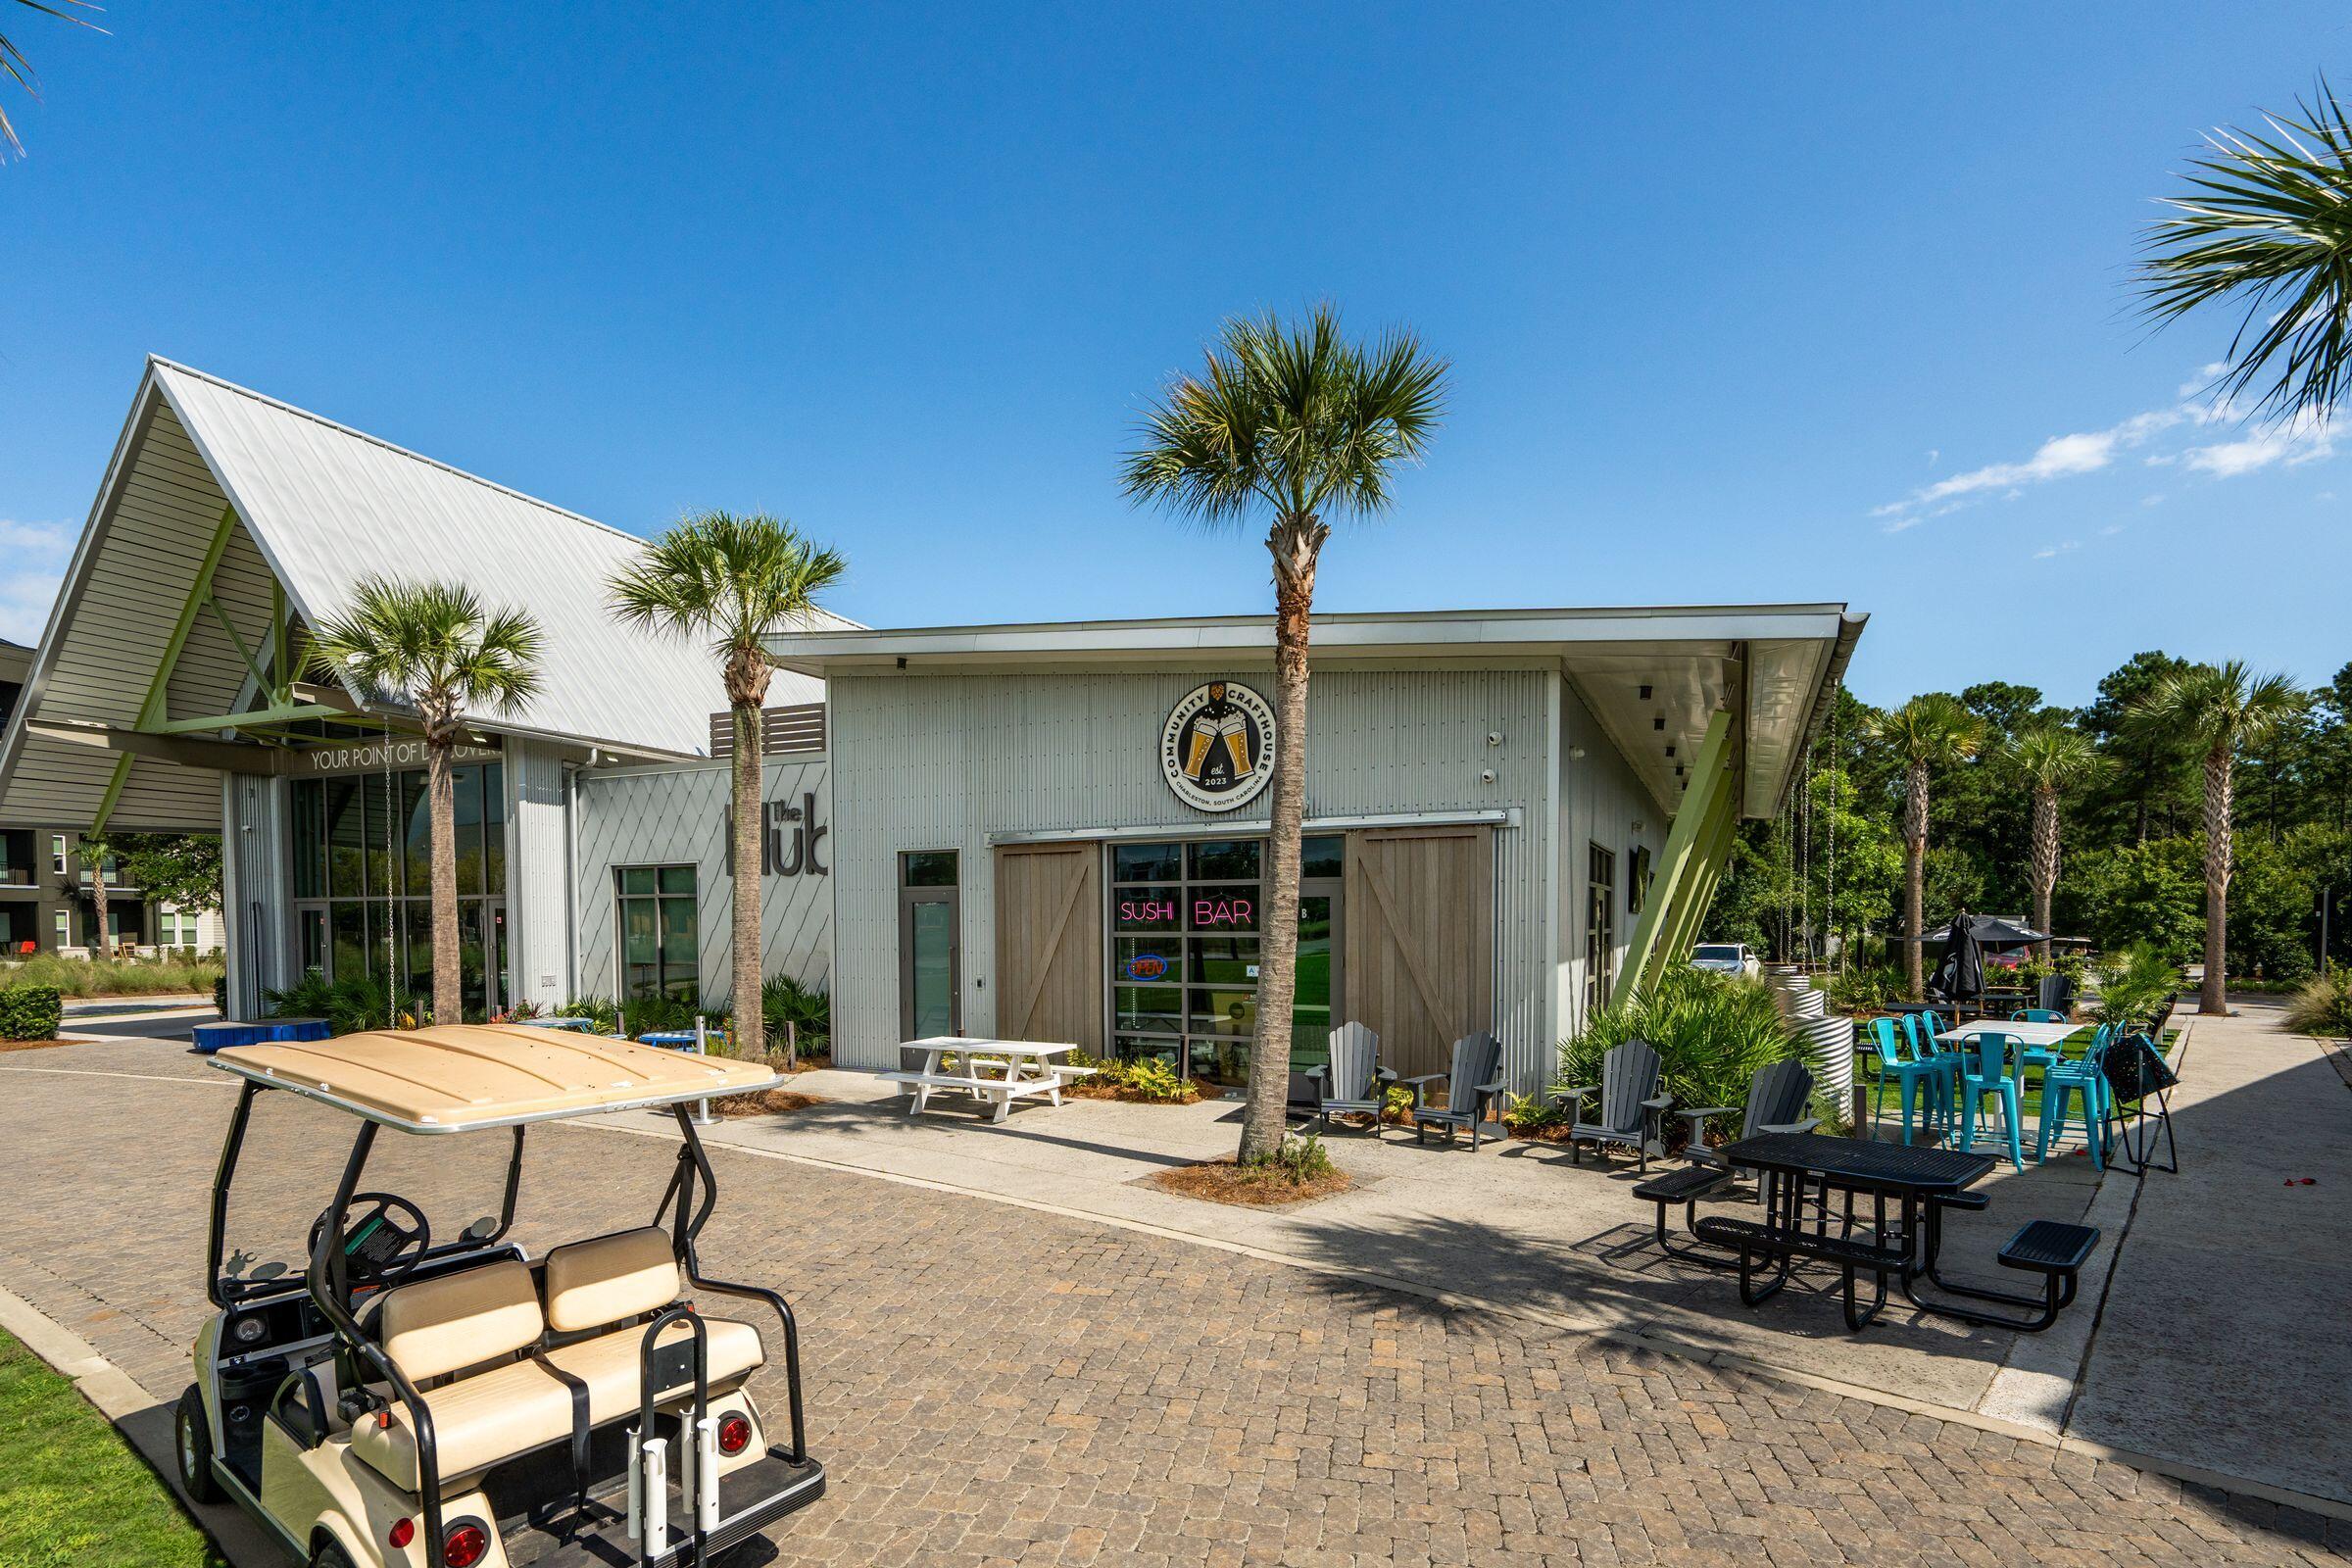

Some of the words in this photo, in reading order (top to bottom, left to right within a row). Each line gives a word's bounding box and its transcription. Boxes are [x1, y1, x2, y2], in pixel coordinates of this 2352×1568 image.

[1166, 693, 1204, 778] COMMUNITY
[1228, 690, 1273, 772] CRAFTHOUSE
[312, 749, 349, 770] YOUR
[353, 746, 392, 766] POINT
[397, 743, 417, 762] OF
[1176, 782, 1211, 806] CHARLESTON,
[1236, 775, 1263, 801] CAROLINA
[770, 799, 803, 822] The
[1121, 901, 1174, 920] SUSHI
[1195, 900, 1251, 925] BAR
[1131, 960, 1163, 975] OPEN
